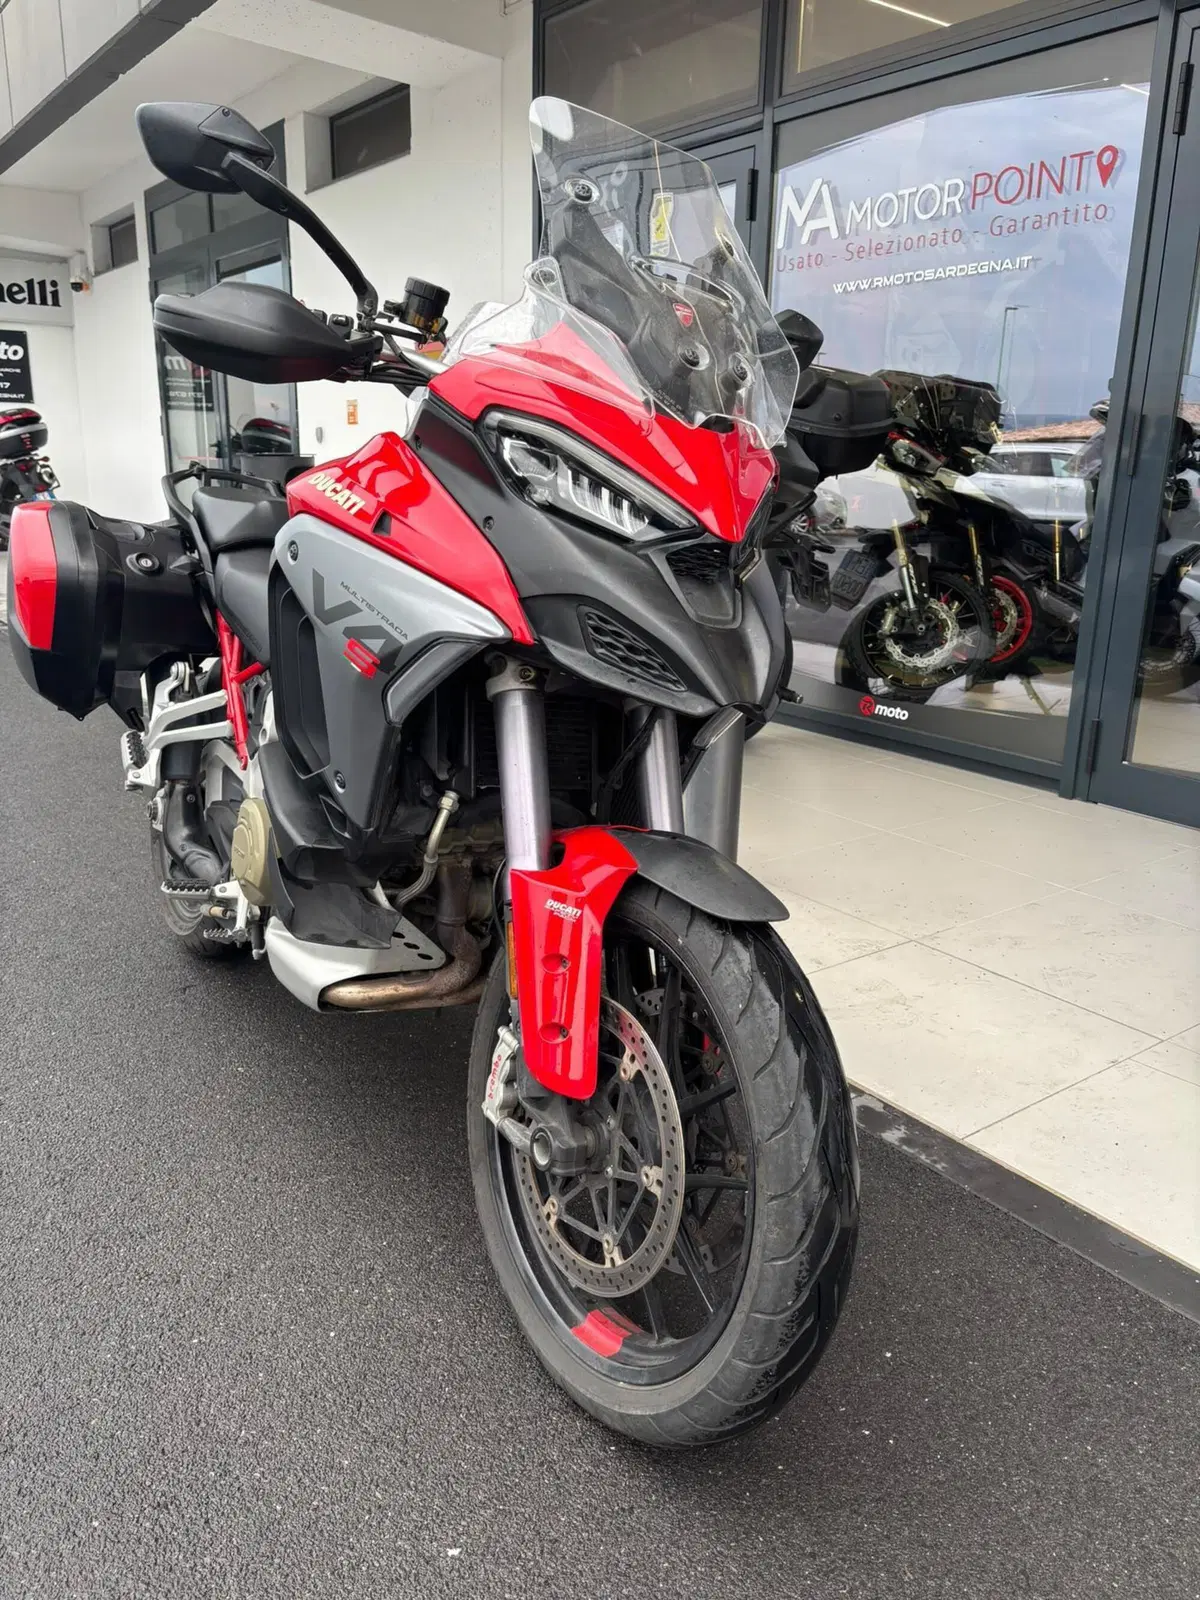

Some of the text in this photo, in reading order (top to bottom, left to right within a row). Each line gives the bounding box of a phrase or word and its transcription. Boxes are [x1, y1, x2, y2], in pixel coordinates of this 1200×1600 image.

[776, 252, 824, 273] Usato
[845, 227, 963, 262] Selezionato
[989, 203, 1108, 237] Garantito
[833, 255, 1033, 294] WWW.RMOTOSARDEGNA.IT
[308, 474, 366, 515] DUCATI
[340, 581, 409, 641] MULTISTRADA
[874, 704, 909, 721] moto
[545, 898, 583, 917] DUCATI
